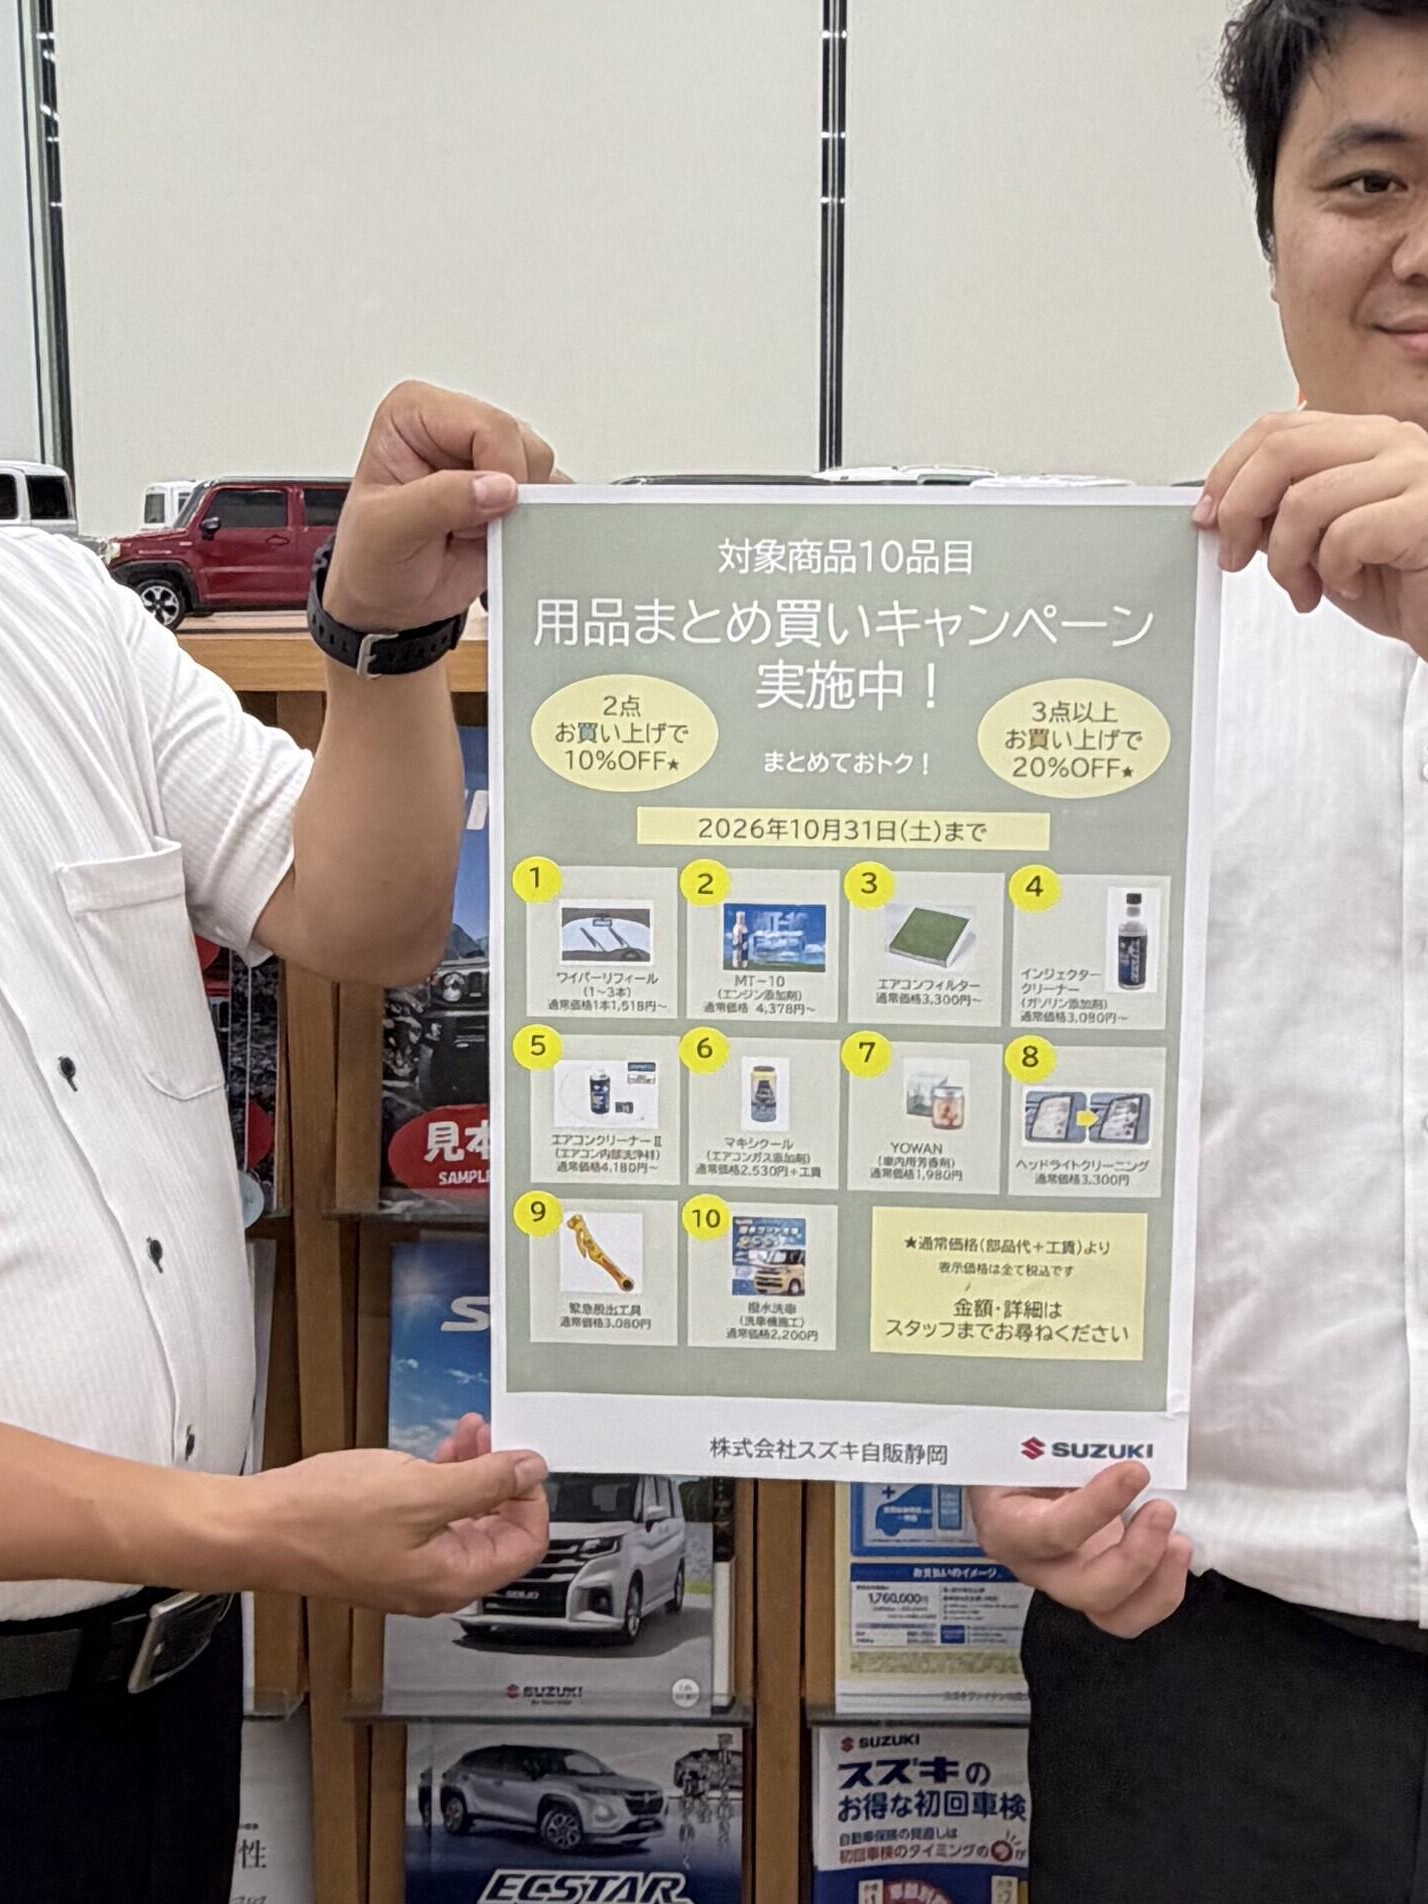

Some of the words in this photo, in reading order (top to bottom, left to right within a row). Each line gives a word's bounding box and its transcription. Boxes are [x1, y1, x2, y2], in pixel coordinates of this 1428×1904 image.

[717, 538, 974, 576] 対象商品10品目
[533, 598, 1154, 650] 用品まとめ買いキャンペーン
[755, 661, 937, 712] 実施中！
[602, 694, 641, 718] 2点
[1032, 701, 1118, 724] 3点以上
[555, 720, 689, 745] お買い上げで
[1004, 727, 1143, 753] お買い上げで
[763, 750, 931, 775] まとめておトク！
[697, 817, 987, 845] 2026年10月31日(土)まで
[529, 866, 541, 889] 1
[697, 873, 714, 895] 2
[860, 872, 878, 895] 3
[1024, 875, 1044, 897] 4
[556, 971, 659, 985] ワイパーリフィール
[877, 978, 981, 993] エアコンフィルター
[1020, 968, 1102, 981] インジェクター
[1020, 982, 1080, 995] クリーナー
[530, 1034, 546, 1056] 5
[696, 1037, 713, 1059] 6
[858, 1041, 876, 1063] 7
[1021, 1045, 1040, 1068] 8
[724, 1136, 794, 1150] マキシクール
[890, 1141, 943, 1155] YOWAN
[1015, 1159, 1150, 1174] ヘッドライトクリーニング
[530, 1200, 546, 1222] 9
[691, 1208, 720, 1229] 10
[938, 1261, 1075, 1278] 表示価格は全て税込です
[953, 1297, 1062, 1320] 金額・詳細は
[885, 1319, 1129, 1343] スタッフまでお尋ねください
[710, 1437, 948, 1466] 株式会社スズキ自販静岡
[1051, 1442, 1153, 1459] SUZUKI
[522, 1685, 584, 1698] SUZUKI
[858, 1733, 921, 1748] SUZUKI
[837, 1755, 992, 1790] スズキの
[837, 1790, 1028, 1823] お得な初回車検
[839, 1827, 958, 1845] 自動車保険の見直しは
